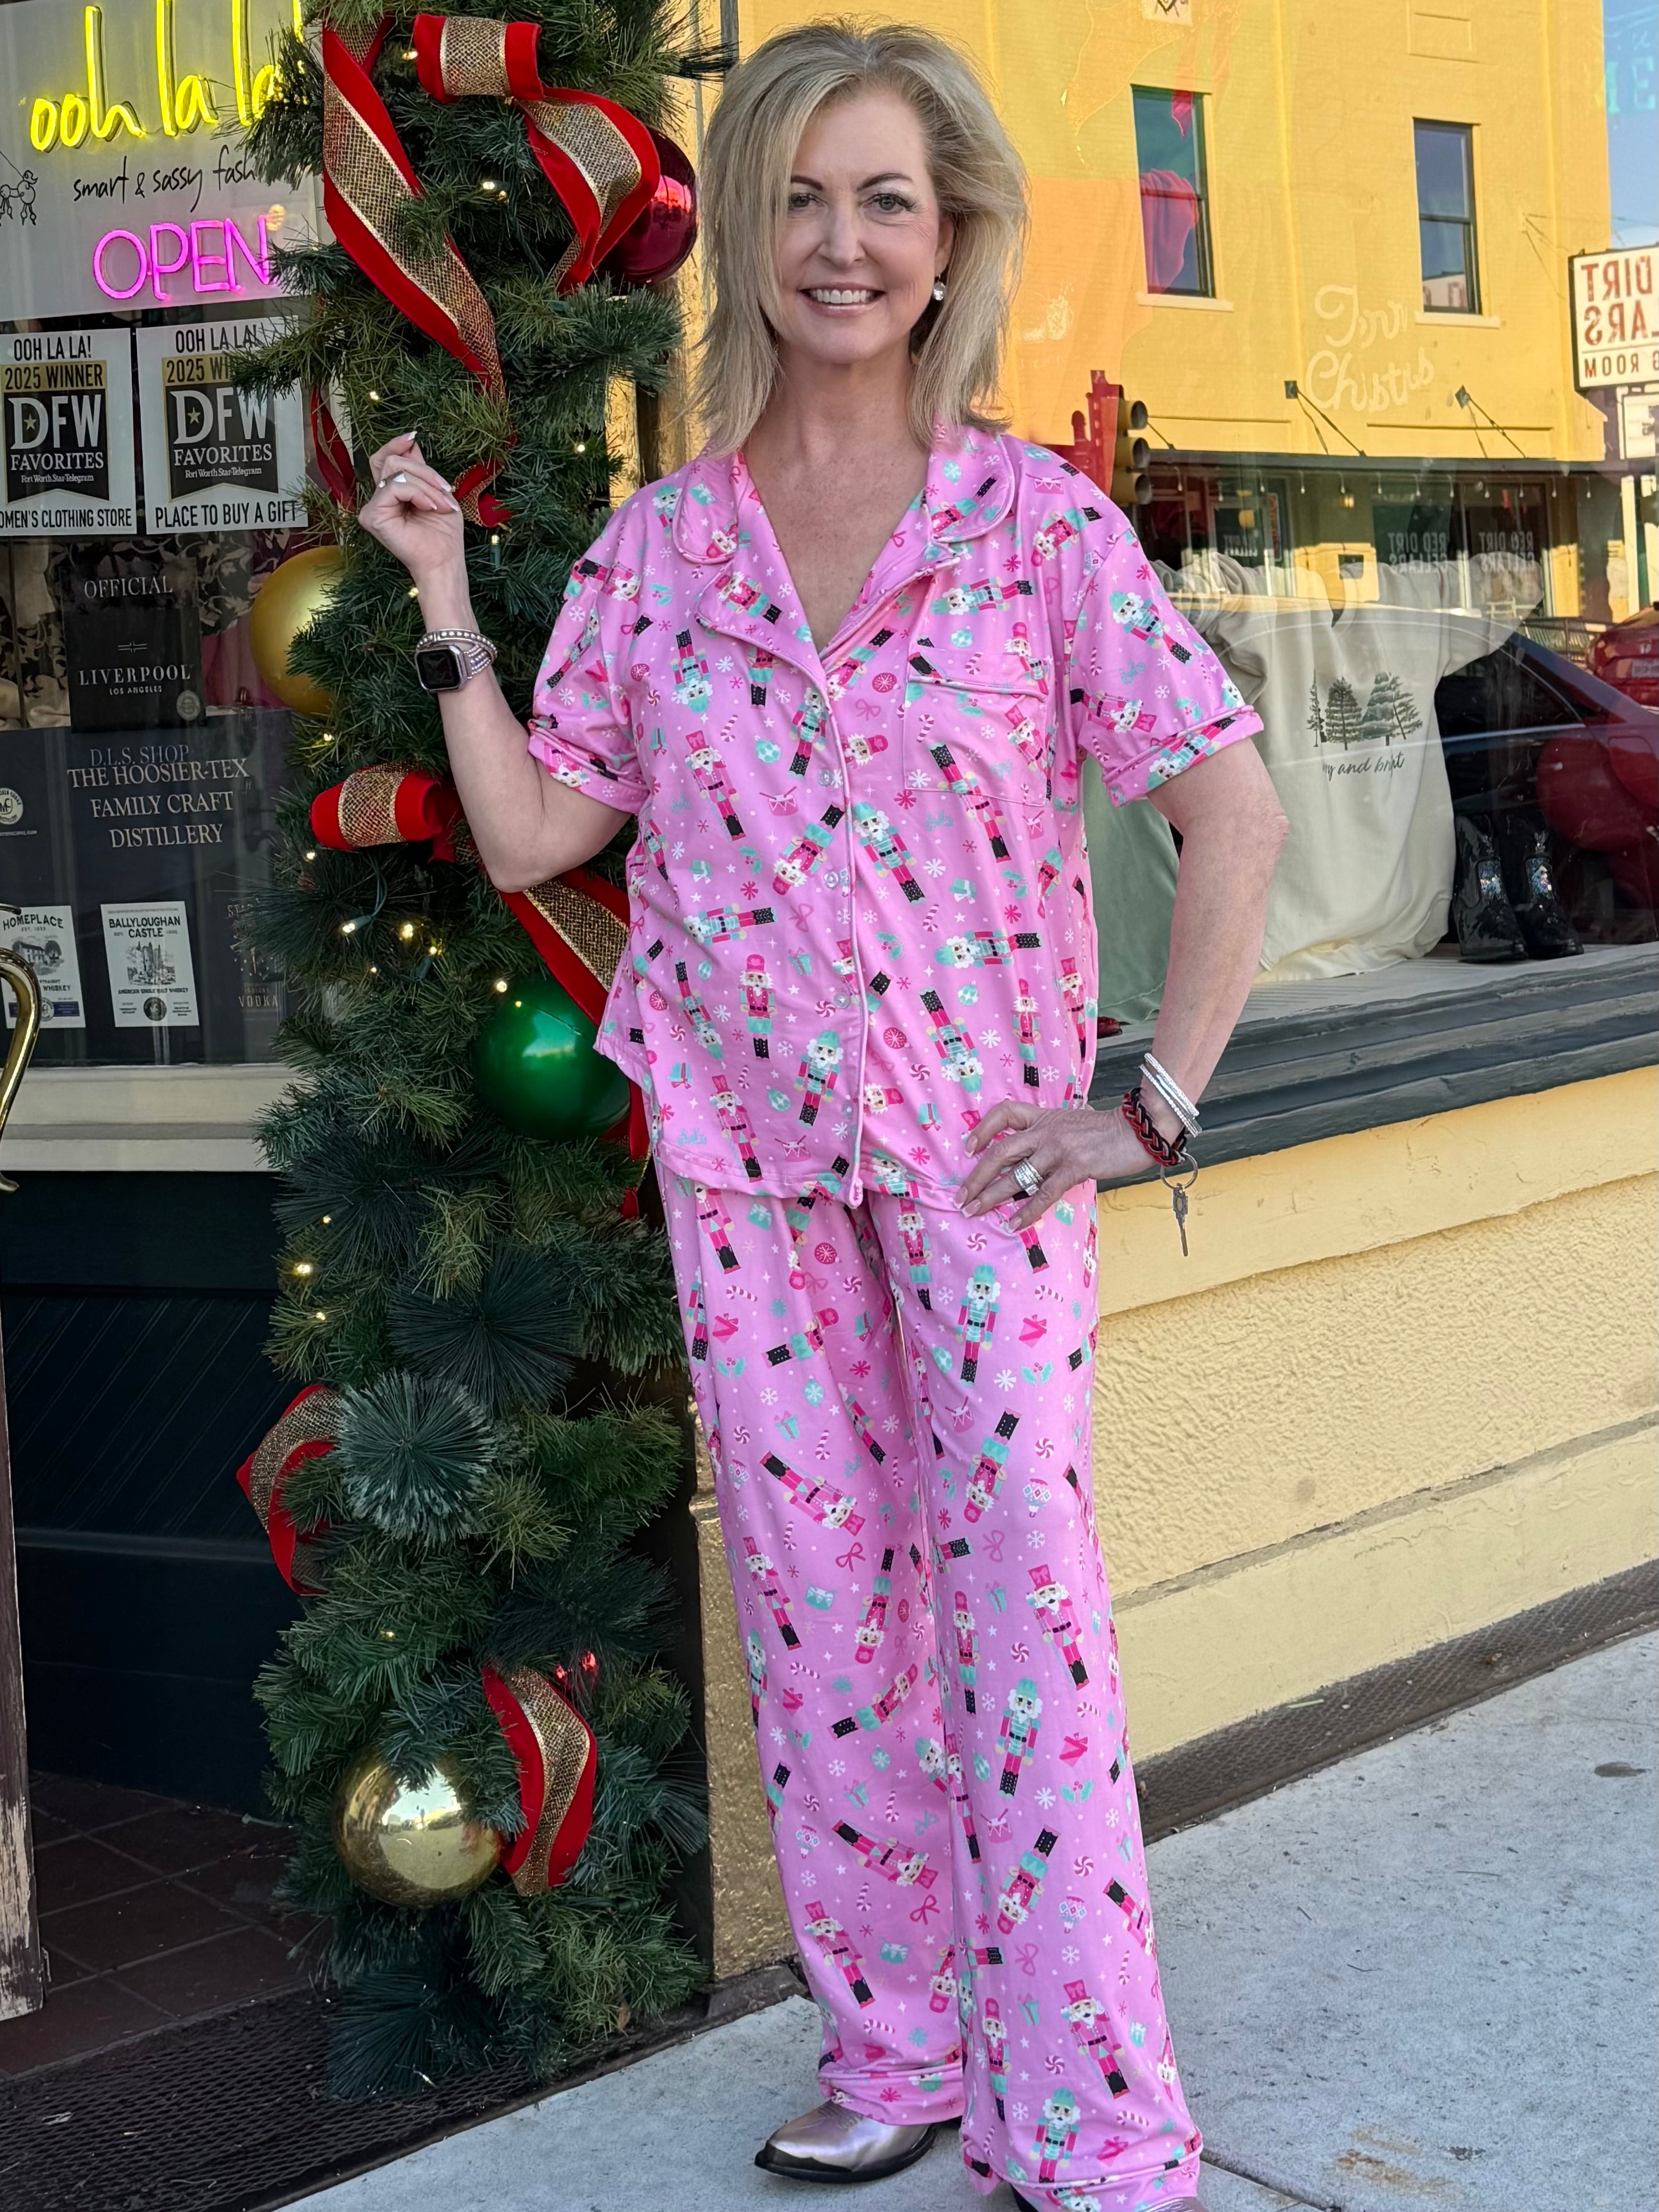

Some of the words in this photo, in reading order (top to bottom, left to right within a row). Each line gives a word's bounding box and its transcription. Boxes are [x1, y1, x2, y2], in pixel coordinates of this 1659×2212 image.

[30, 5, 145, 152] ooh
[156, 0, 219, 137] la
[73, 155, 129, 204] smart
[135, 172, 145, 198] &
[153, 167, 202, 213] sassy
[213, 144, 255, 191] fash
[93, 215, 270, 299] OPEN
[14, 339, 41, 361] OOH
[47, 337, 64, 360] LA
[69, 336, 92, 359] LA!
[176, 330, 205, 352] OOH
[211, 328, 228, 350] LA
[5, 367, 41, 390] 2025
[46, 364, 103, 388] WINNER
[166, 359, 204, 382] 2025
[8, 394, 101, 449] DFW
[170, 388, 266, 444] DFW
[11, 452, 104, 471] FAVORITES
[174, 444, 272, 466] FAVORITES
[21, 475, 34, 483] Fort
[35, 474, 52, 483] Worth
[185, 469, 198, 478] Fort
[198, 468, 218, 478] Worth
[0, 511, 38, 529] OMEN'S
[41, 509, 94, 528] CLOTHING
[97, 508, 132, 527] STORE
[155, 505, 198, 528] PLACE
[201, 504, 218, 525] TO
[223, 502, 249, 525] BUY
[254, 502, 264, 523] A
[269, 501, 296, 522] GIFT
[84, 576, 173, 599] OFFICIAL
[79, 664, 191, 686] LIVERPOOL
[110, 687, 126, 695] LOS
[128, 685, 162, 695] ANGELES
[90, 748, 136, 767] D.L.S.
[139, 744, 189, 766] SHOP
[1338, 758, 1372, 775] and
[68, 768, 110, 788] THE
[114, 758, 251, 786] HOOSIER-TEX
[90, 797, 161, 818] FAMILY
[167, 791, 234, 813] CRAFT
[110, 824, 223, 848] DISTILLERY
[3, 914, 64, 930] HOMEPLACE
[109, 916, 181, 928] BALLYLOUGHAN
[128, 928, 164, 938] CASTLE
[238, 995, 278, 1007] VODKA
